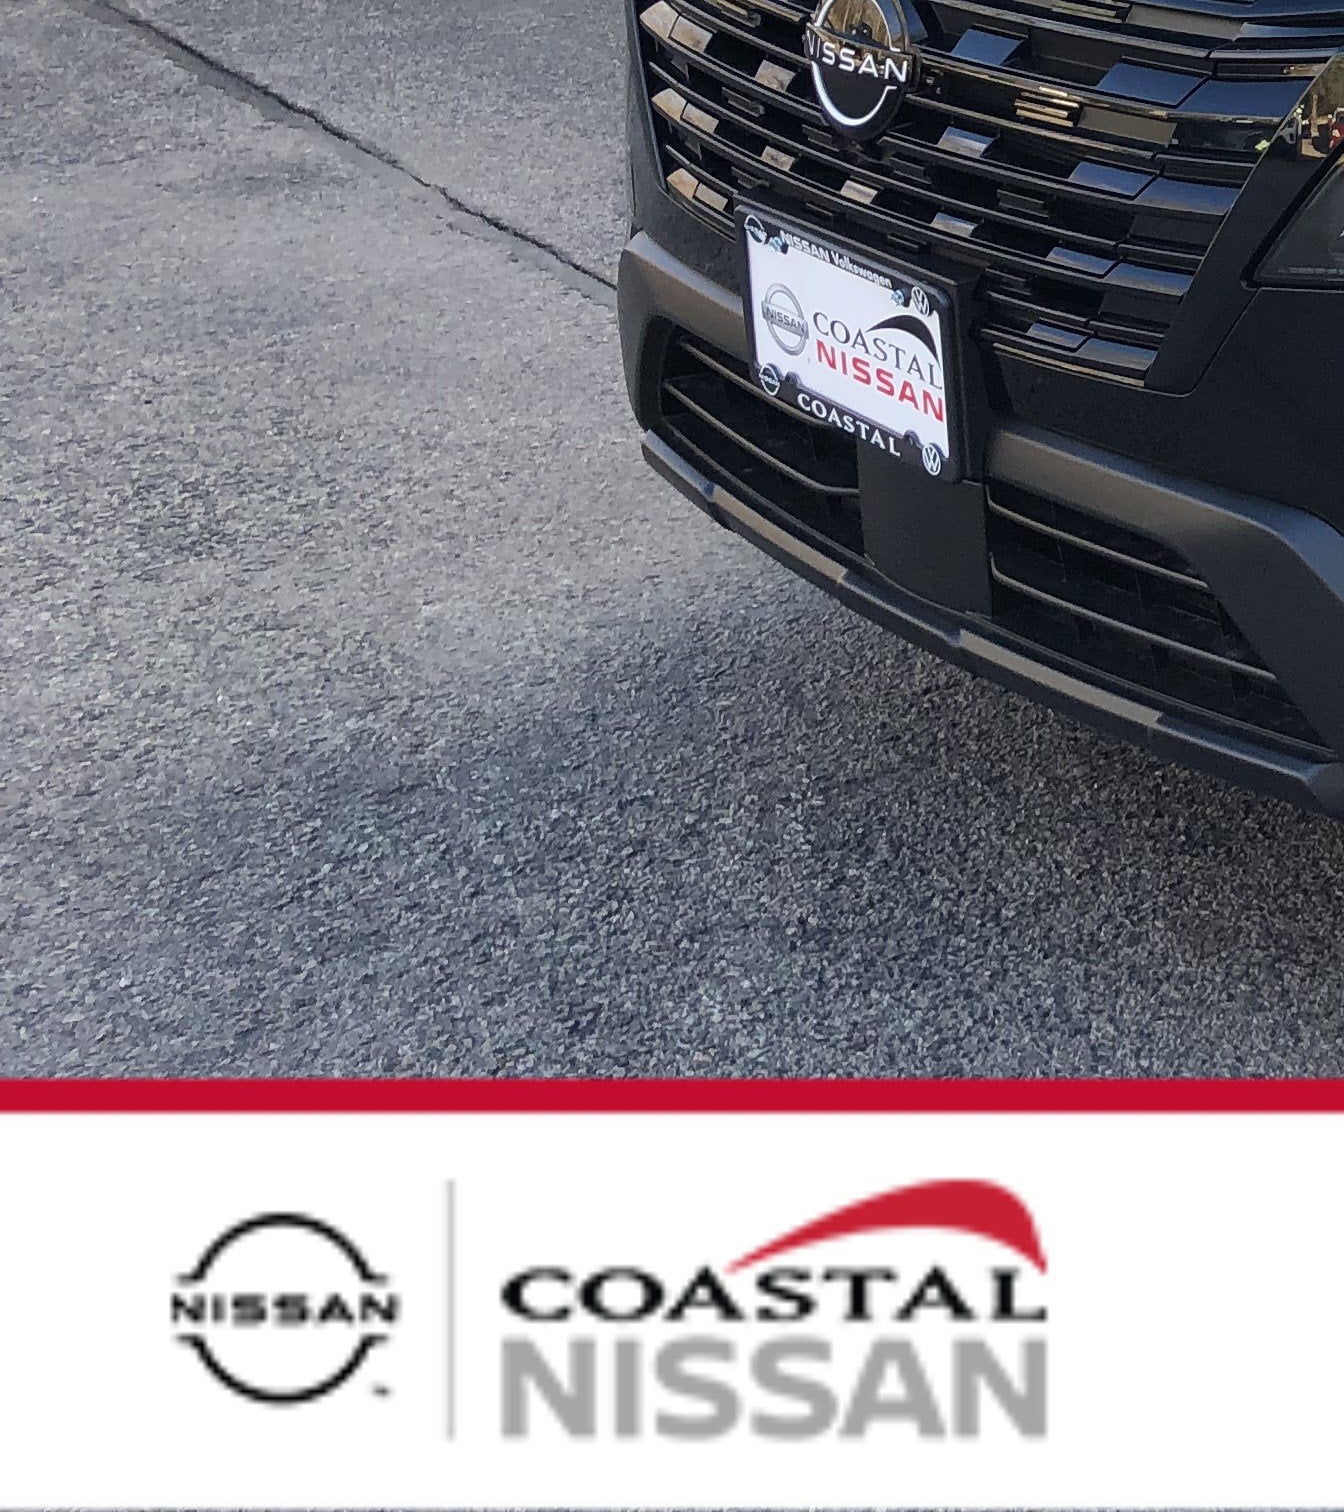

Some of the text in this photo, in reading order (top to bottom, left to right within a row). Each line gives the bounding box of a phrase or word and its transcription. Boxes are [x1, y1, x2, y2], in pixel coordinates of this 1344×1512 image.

[806, 29, 909, 83] NISSAN
[779, 230, 830, 263] NISSAN
[830, 250, 893, 289] Volkswagen
[766, 306, 807, 336] NISSAN
[813, 312, 943, 391] COASTAL
[816, 338, 944, 423] NISSAN
[797, 393, 902, 457] COASTAL
